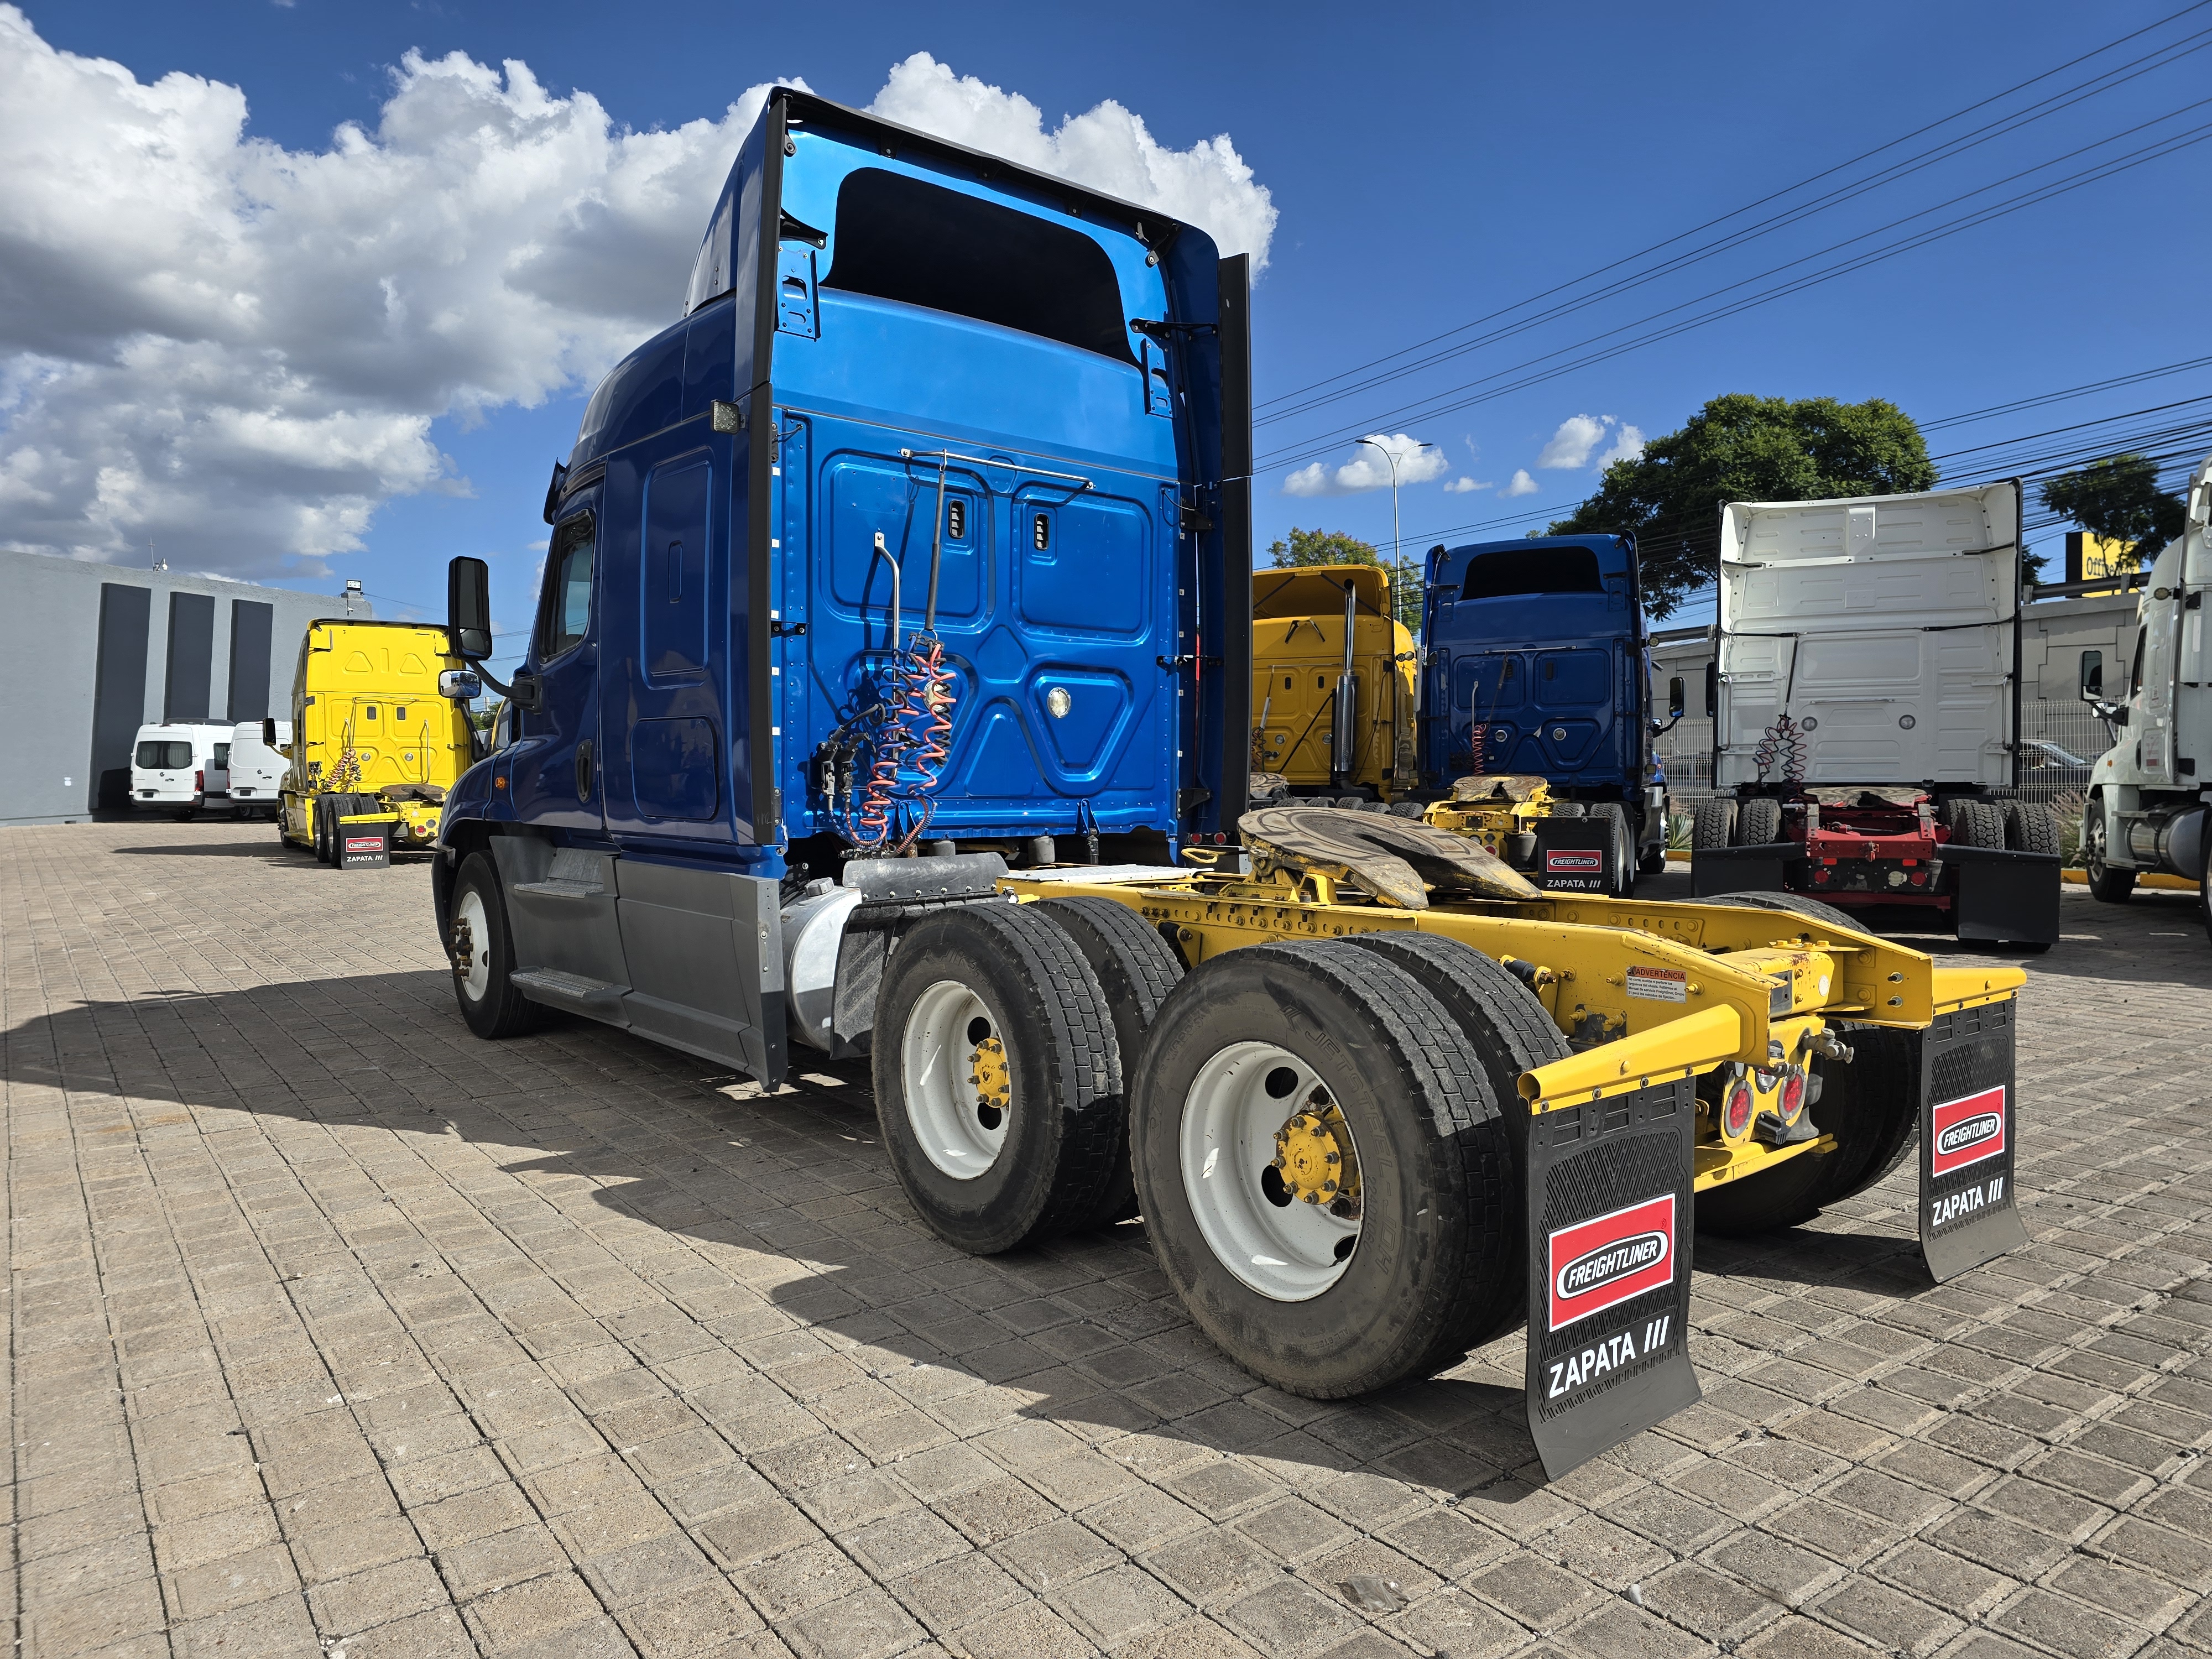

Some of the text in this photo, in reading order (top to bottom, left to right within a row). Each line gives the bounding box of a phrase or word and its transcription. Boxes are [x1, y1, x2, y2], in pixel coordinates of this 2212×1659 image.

[1547, 879, 1585, 888] ZAPATA
[1636, 968, 1685, 980] ADVERTENCIA
[1943, 1118, 1995, 1149] FREIGHTLINER
[1932, 1187, 1984, 1227] ZAPATA
[1567, 1239, 1658, 1290] FREIGHTLINER
[1549, 1332, 1636, 1399] ZAPATA
